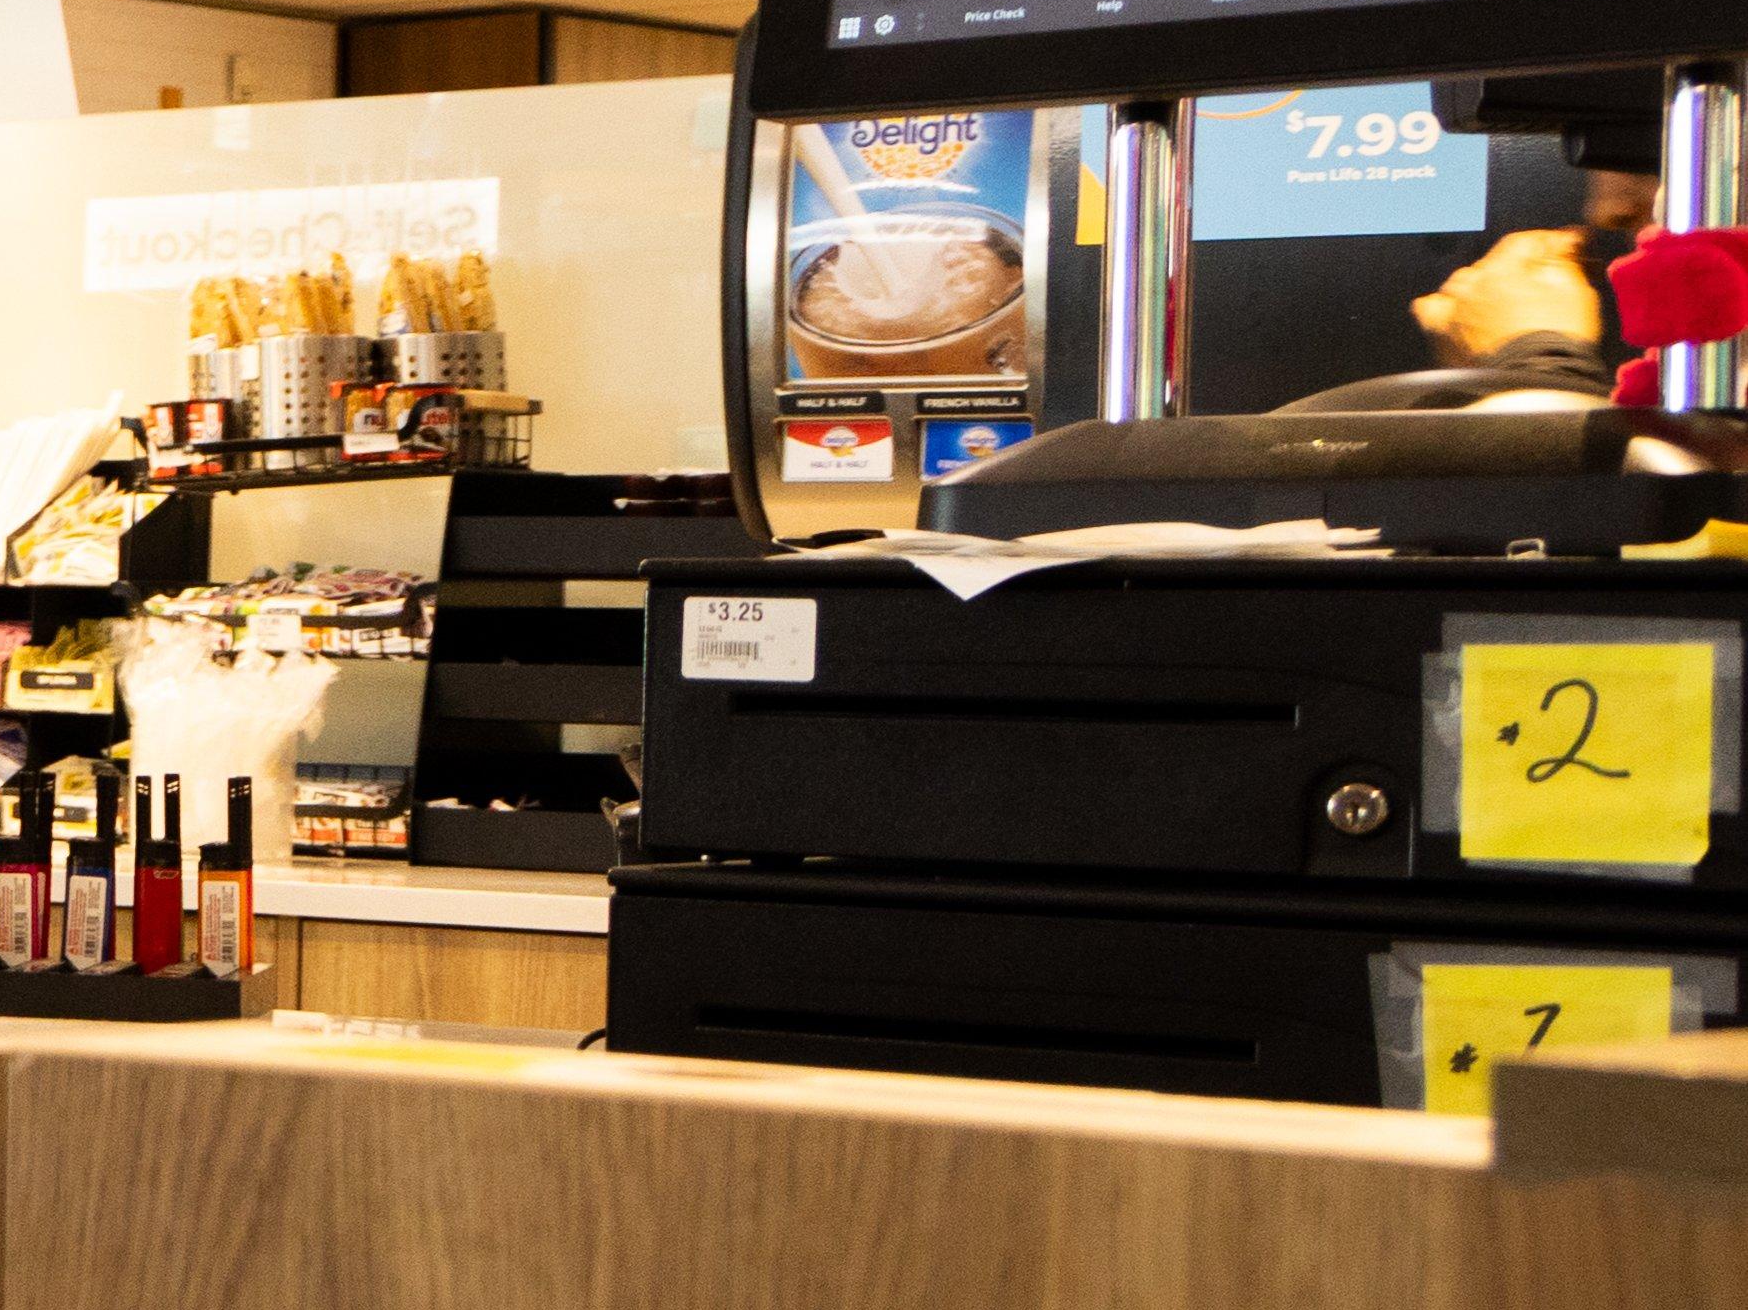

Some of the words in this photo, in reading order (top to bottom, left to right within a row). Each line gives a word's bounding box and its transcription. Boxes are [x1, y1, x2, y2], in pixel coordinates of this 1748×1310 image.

[964, 8, 992, 24] Price
[994, 5, 1026, 21] Check
[1096, 0, 1124, 15] Help
[851, 113, 980, 155] Delight
[1285, 109, 1441, 159] $7.99
[1286, 169, 1326, 184] Pure
[1329, 167, 1363, 181] Life
[1366, 166, 1389, 180] 28
[1391, 164, 1437, 182] pack
[796, 396, 825, 408] HALF
[837, 396, 867, 408] HALF
[923, 397, 971, 409] FRENCH
[972, 397, 1021, 408] VANILLA
[708, 601, 763, 622] $3.25
